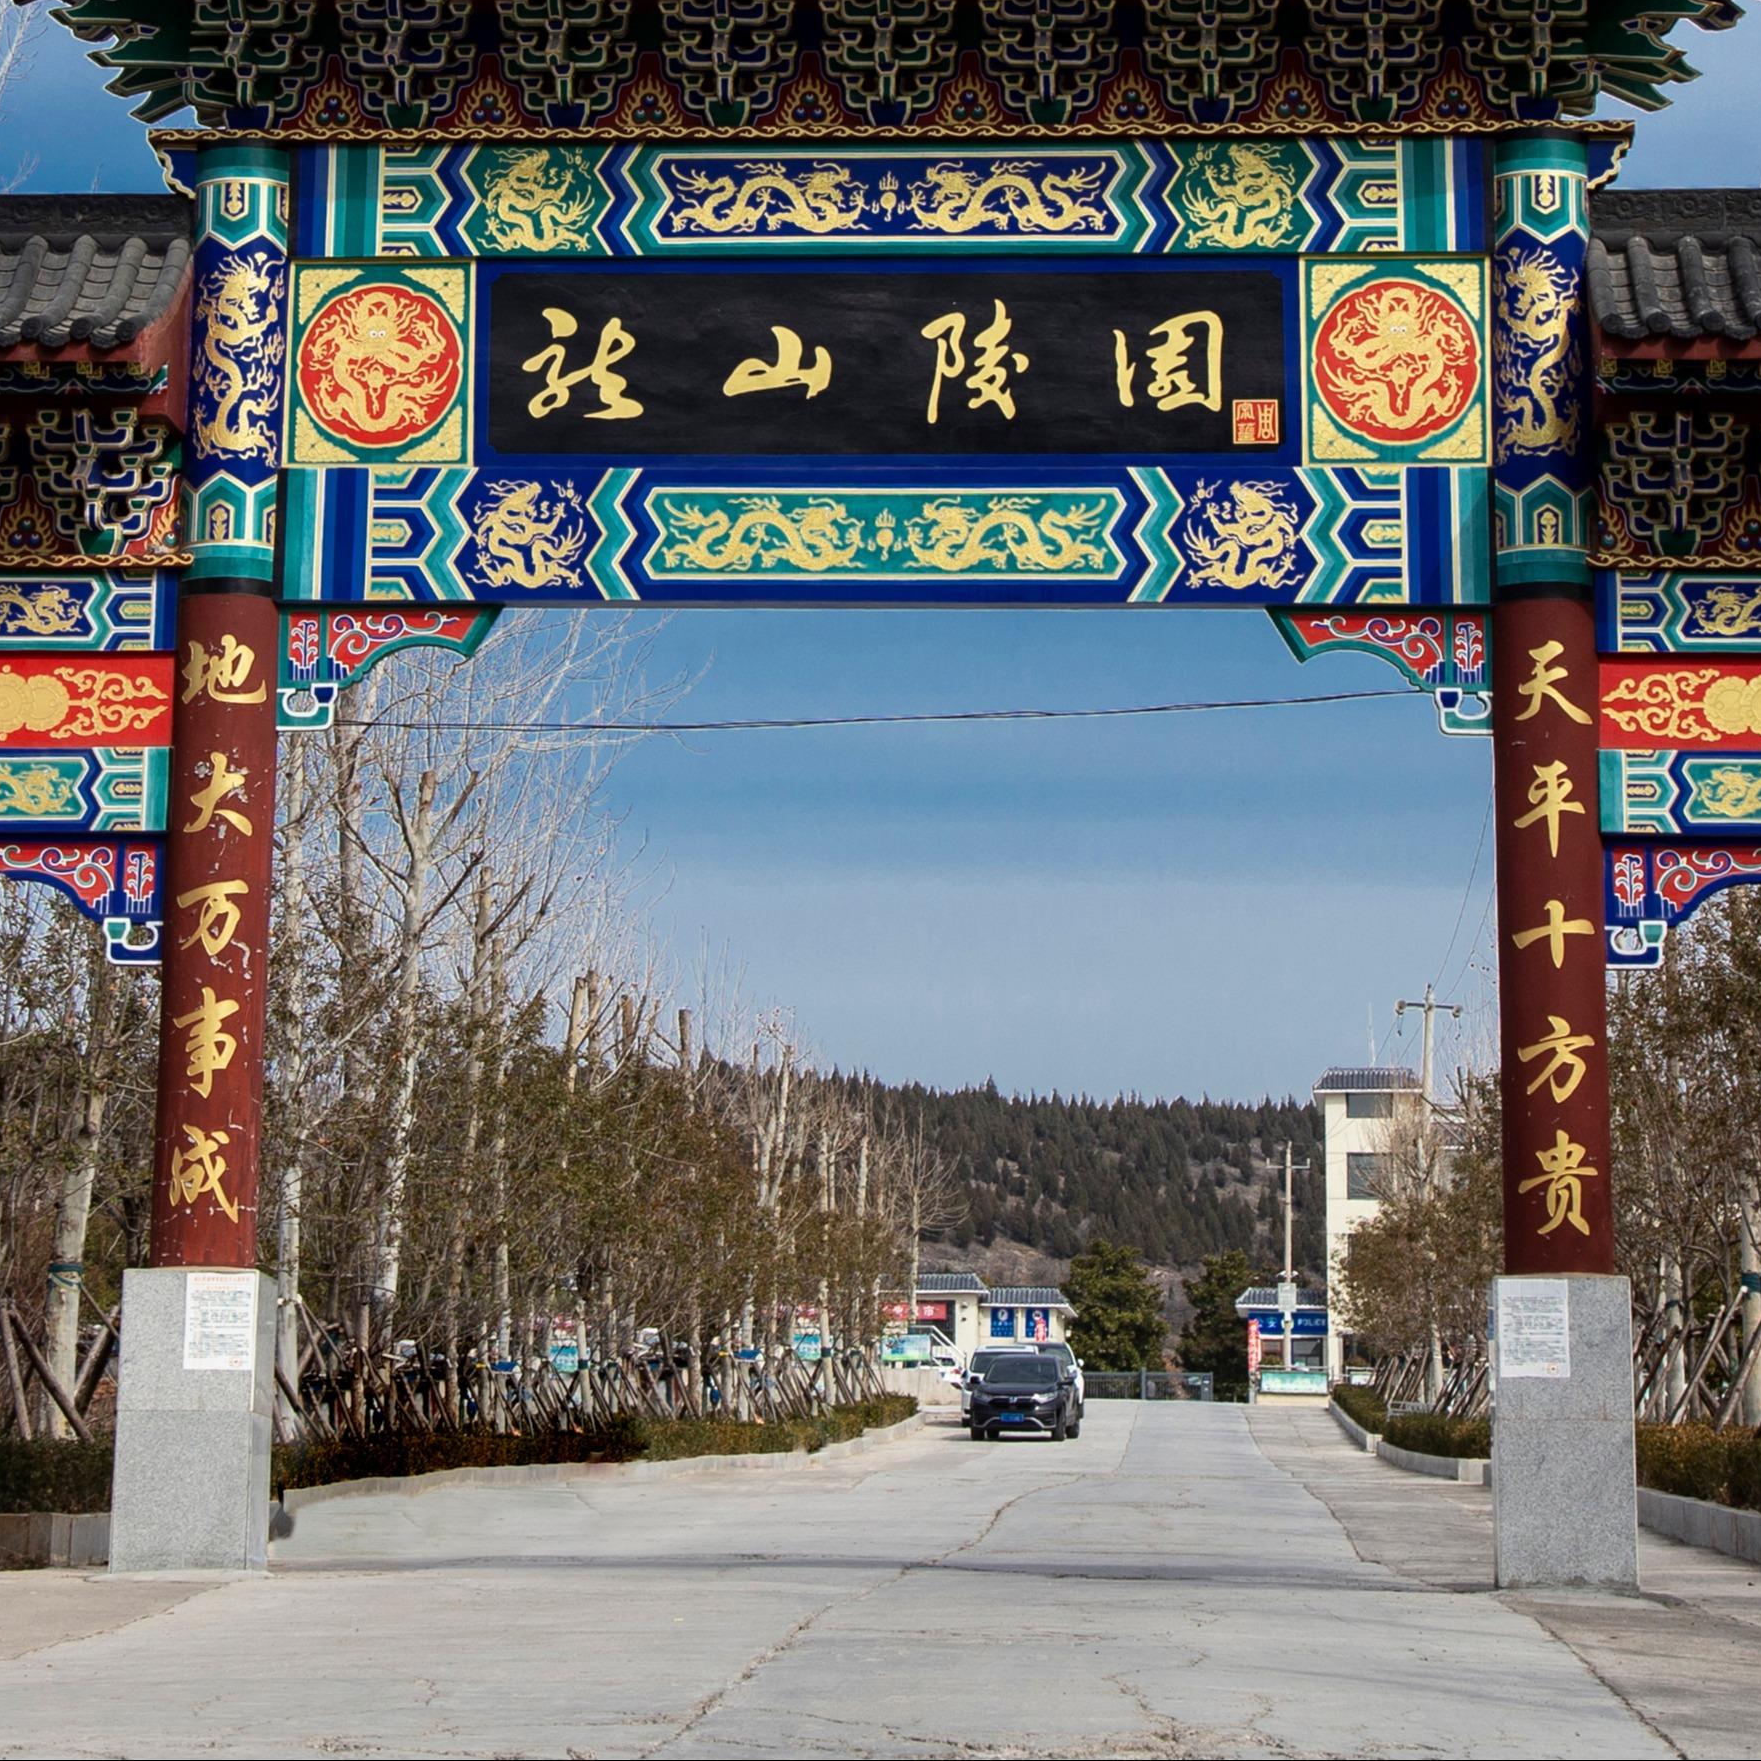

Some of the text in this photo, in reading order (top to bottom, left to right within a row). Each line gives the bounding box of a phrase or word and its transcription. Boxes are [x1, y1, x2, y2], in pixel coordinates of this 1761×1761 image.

[169, 633, 268, 1225] 地大万事成
[1297, 1317, 1326, 1327] POLICE
